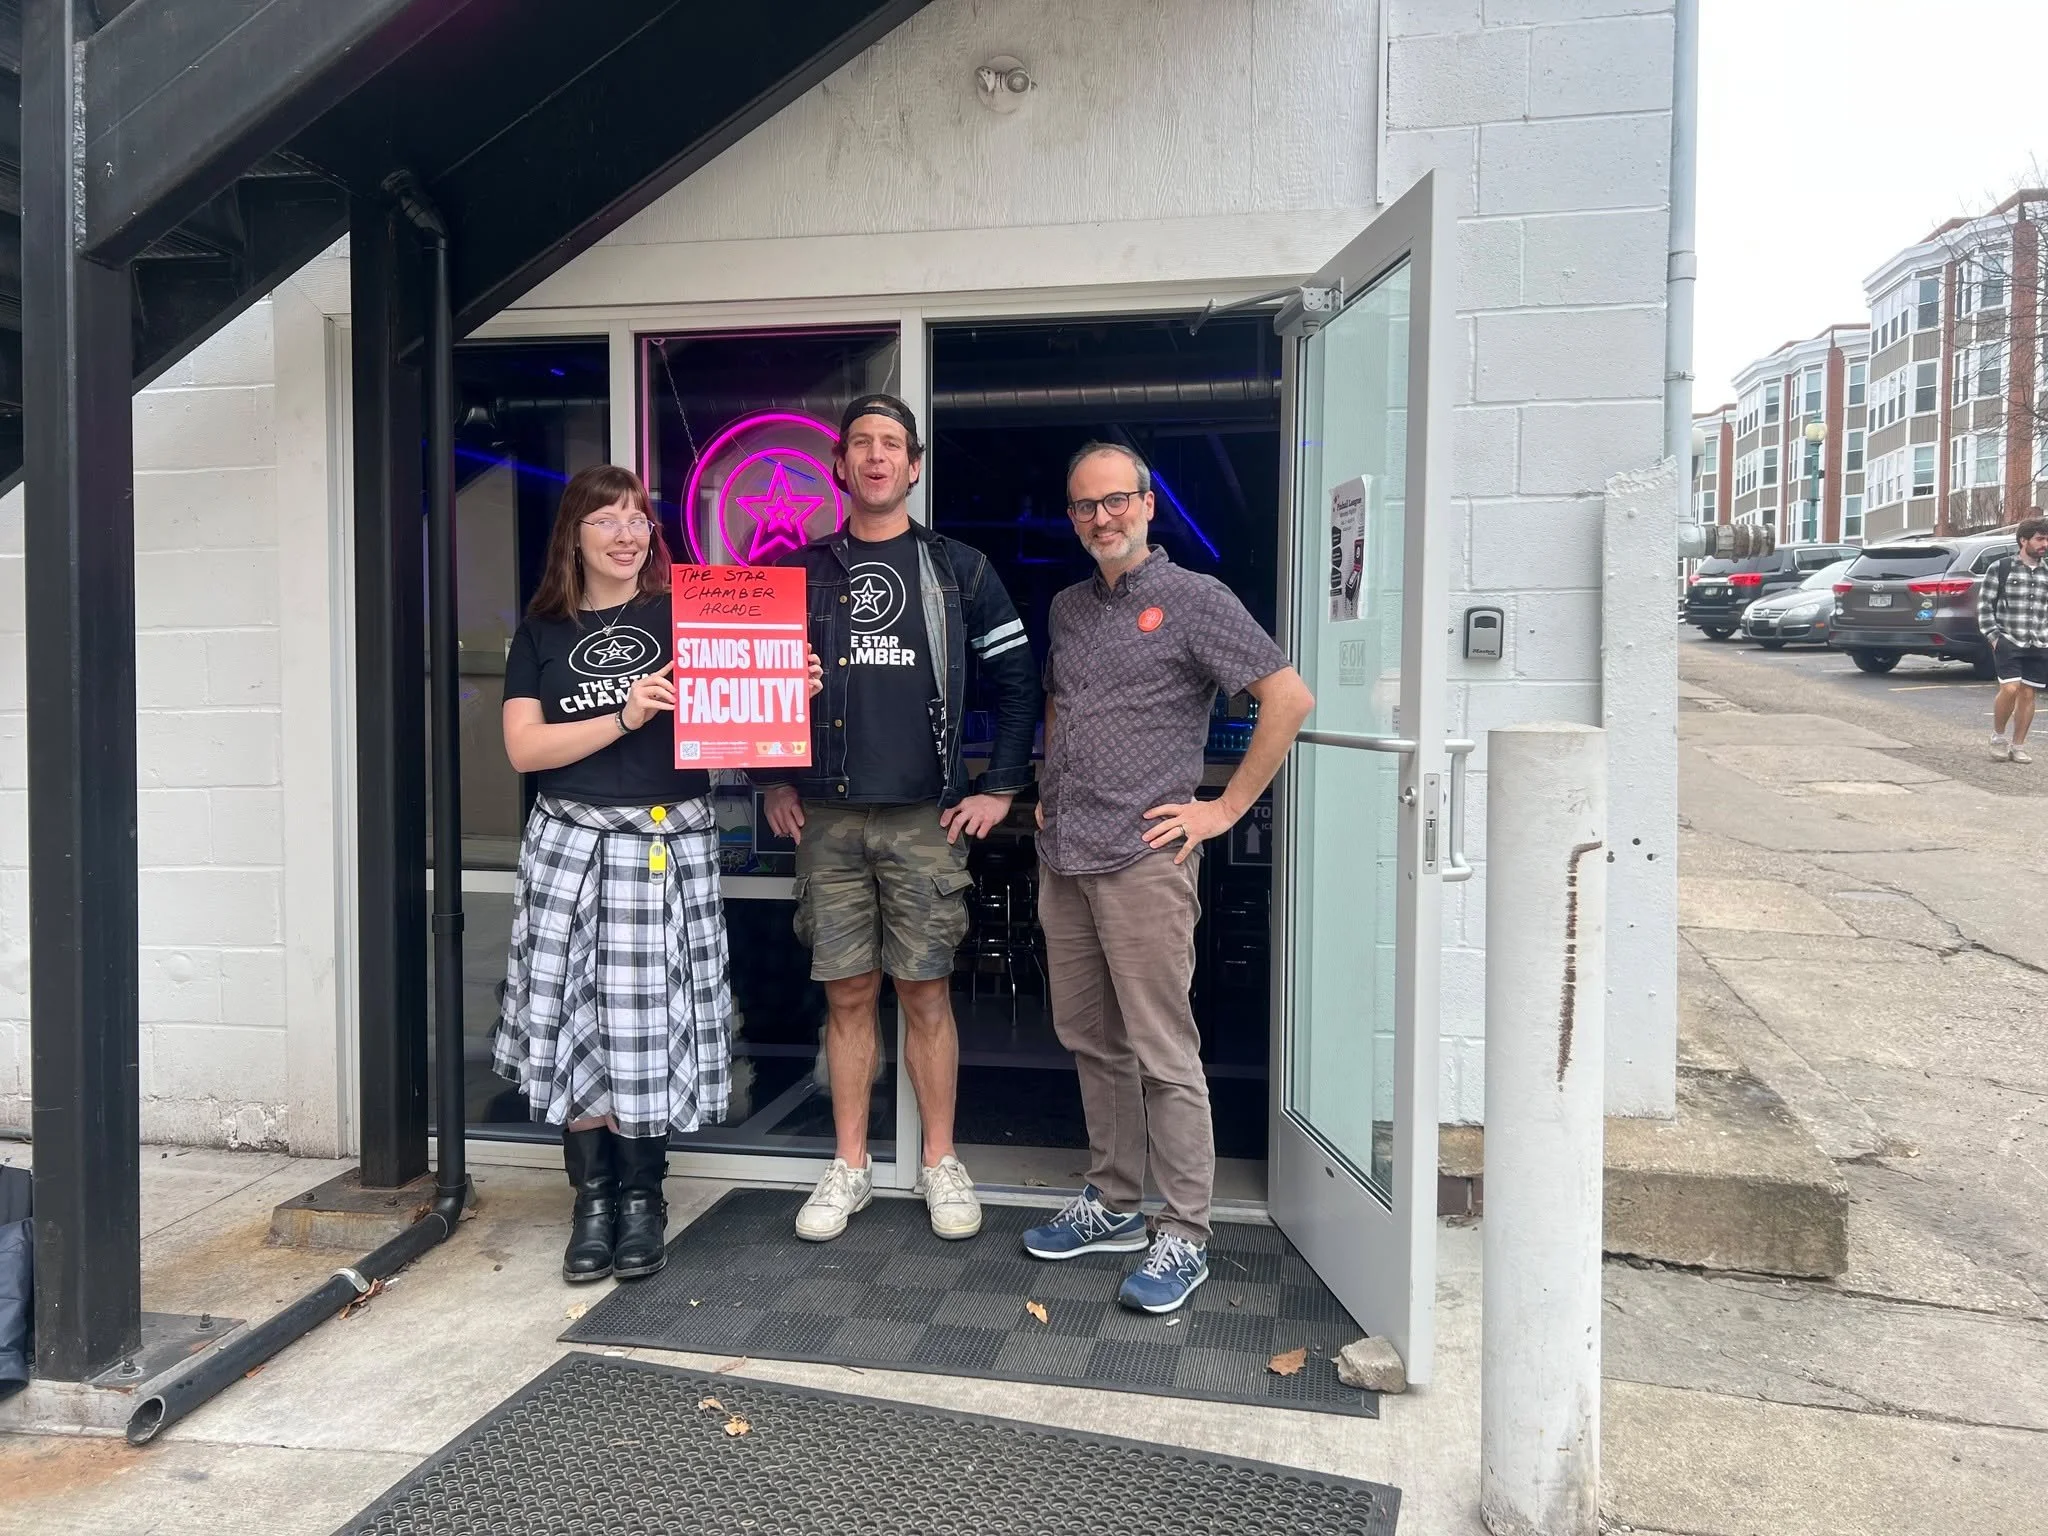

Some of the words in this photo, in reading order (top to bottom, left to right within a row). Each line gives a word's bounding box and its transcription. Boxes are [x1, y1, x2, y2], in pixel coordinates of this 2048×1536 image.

[678, 568, 714, 583] THE
[724, 570, 768, 582] STAR
[684, 586, 775, 600] CHAMBER
[700, 603, 762, 616] ARCADE
[862, 635, 899, 648] STAR
[677, 638, 750, 669] STANDS
[753, 639, 804, 669] WITH
[850, 648, 915, 666] MBER
[578, 679, 615, 694] THE
[560, 688, 632, 714] CHAM
[679, 677, 806, 724] FACULTY!
